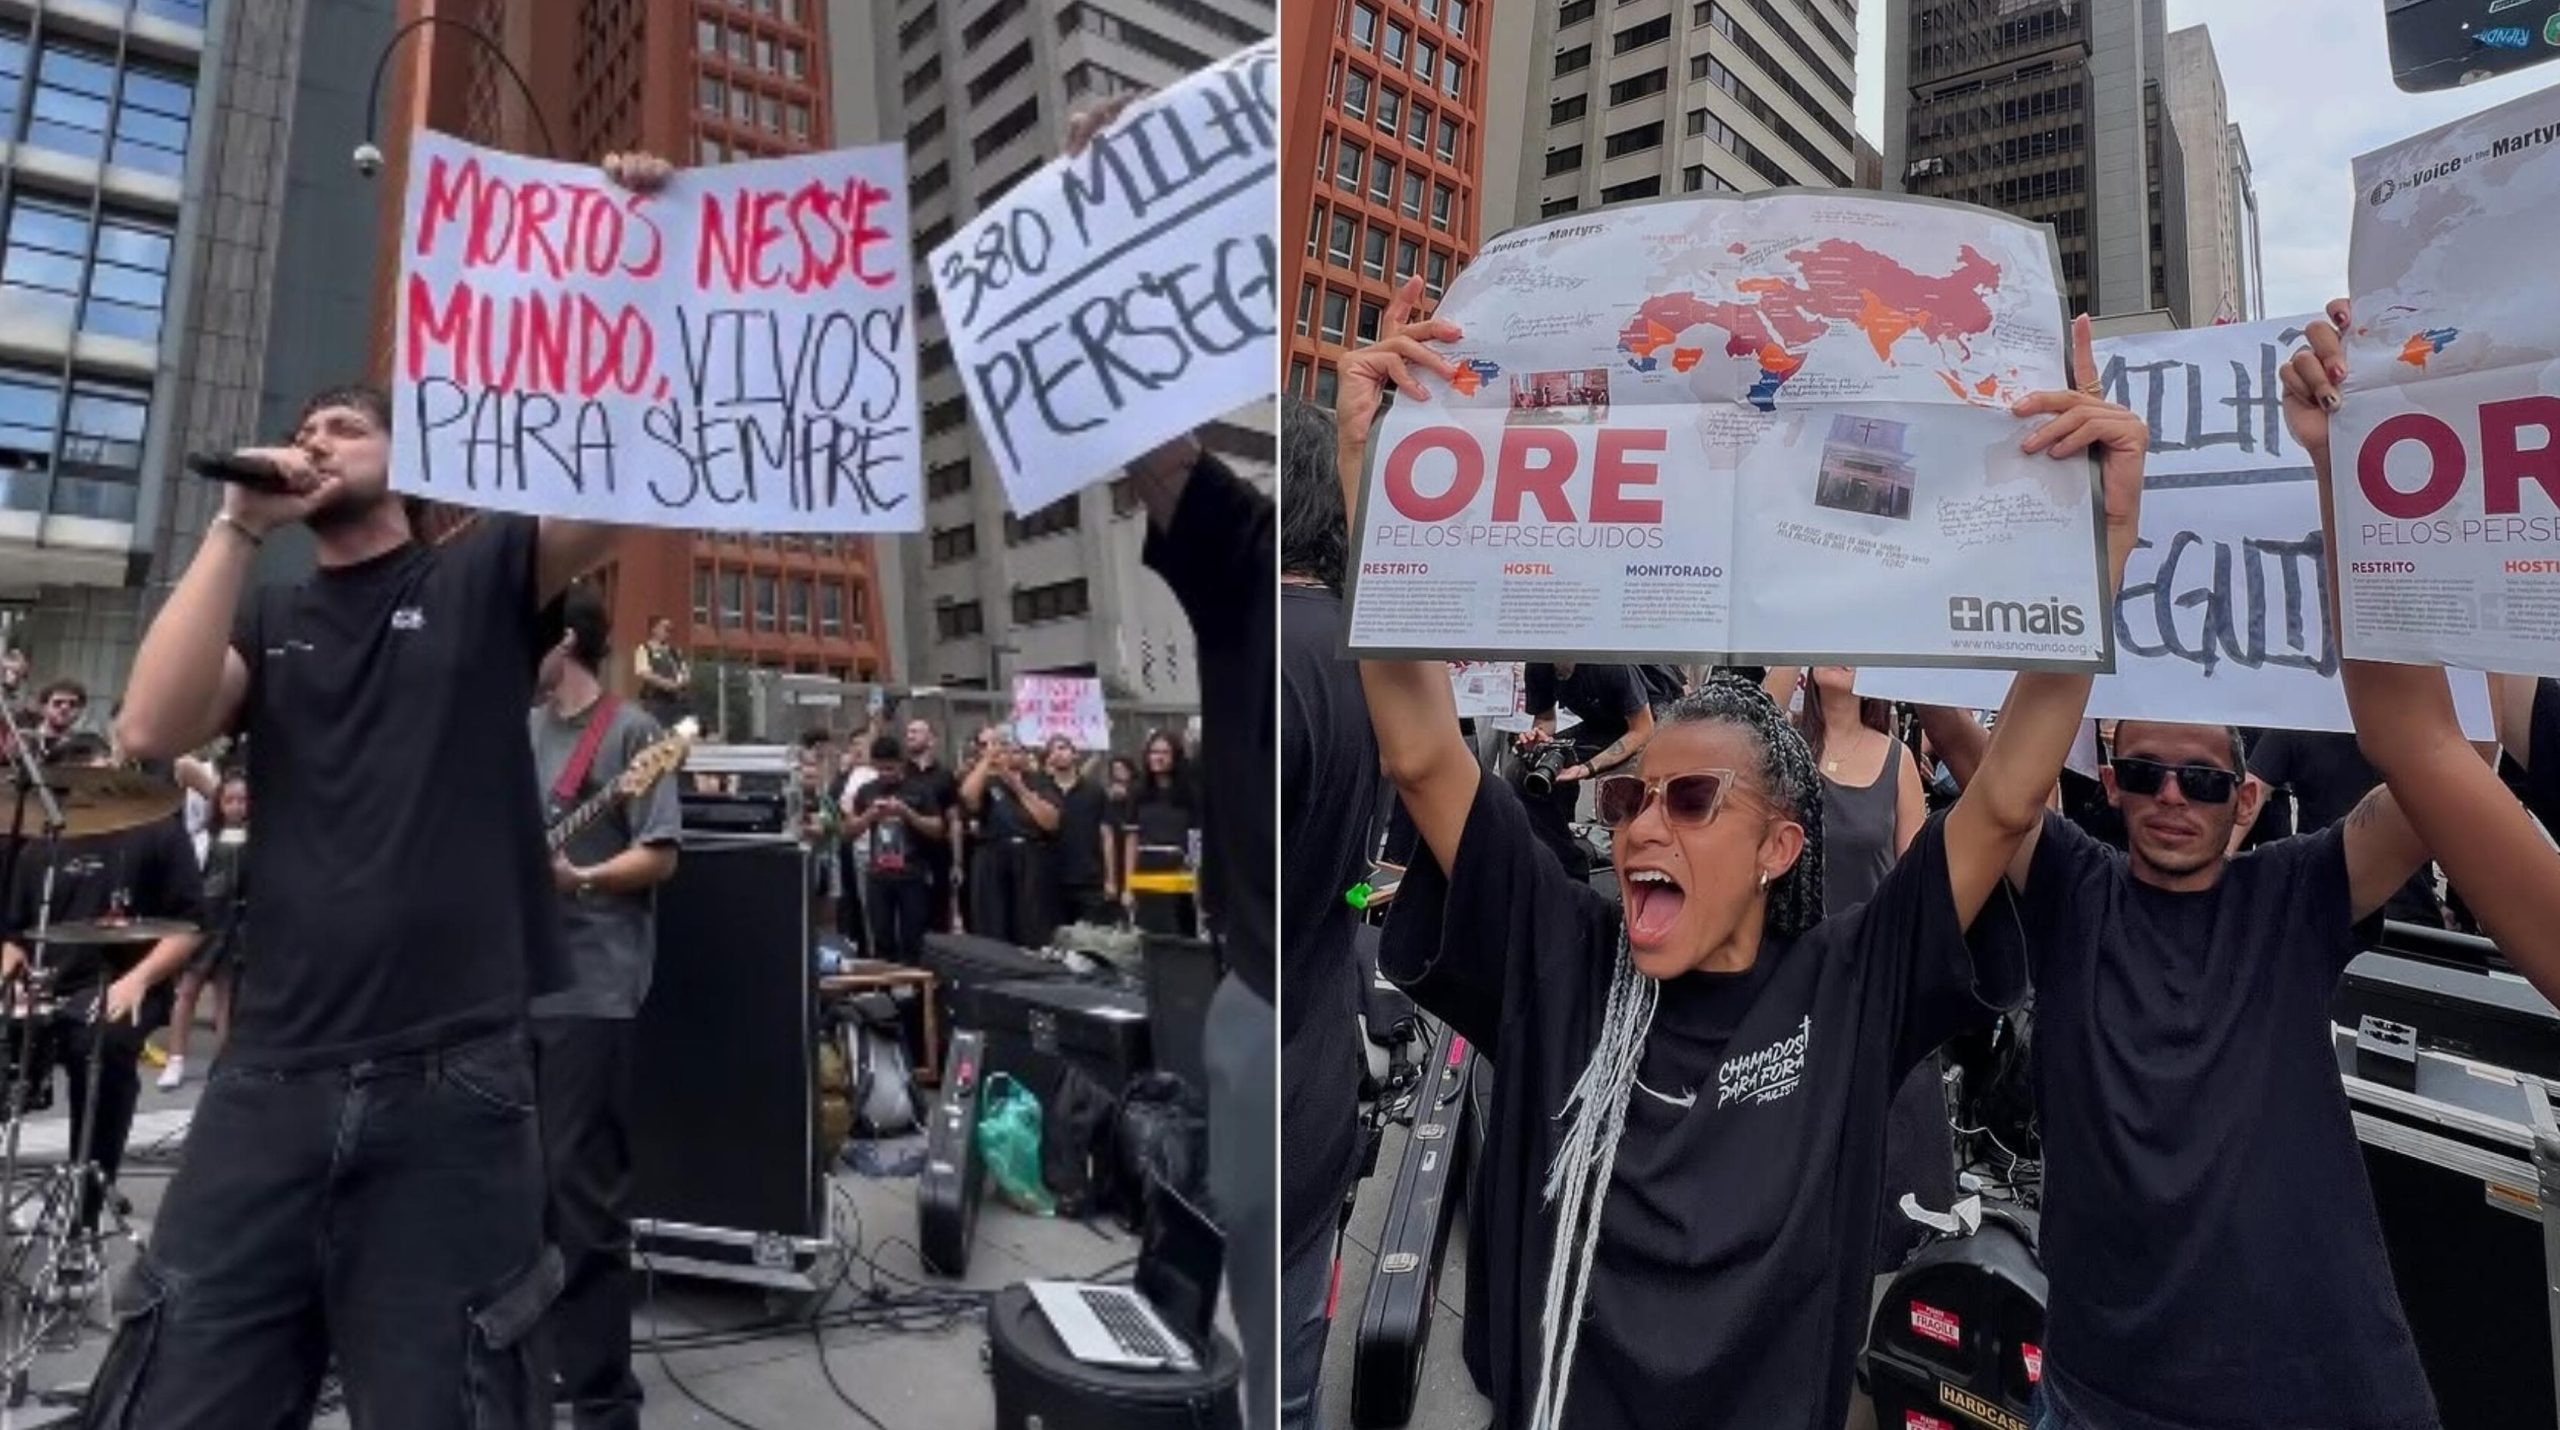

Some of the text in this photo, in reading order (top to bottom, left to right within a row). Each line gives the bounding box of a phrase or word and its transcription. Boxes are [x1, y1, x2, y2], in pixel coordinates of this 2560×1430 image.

[2413, 157, 2461, 188] Voice
[417, 154, 897, 294] MORTOS NESSE
[1491, 238, 1529, 254] Voice
[1548, 224, 1604, 241] Martyrs
[940, 208, 1053, 328] 380
[406, 272, 906, 423] MUNDO, VIVOS
[416, 376, 910, 514] PARA SEMPRE
[1384, 425, 1668, 523] ORE
[1376, 525, 1664, 549] PELOS PERSEGUIDOS
[2361, 520, 2452, 546] PELOS
[1363, 563, 1723, 578] RESTRITO HOSTIL MONITORADO
[2351, 561, 2415, 575] RESTRITO
[1985, 596, 2086, 636] mais
[1718, 1033, 1805, 1085] CHAMADOS
[1718, 1054, 1805, 1110] PARA FORA
[1916, 1315, 1955, 1338] FRAGILE
